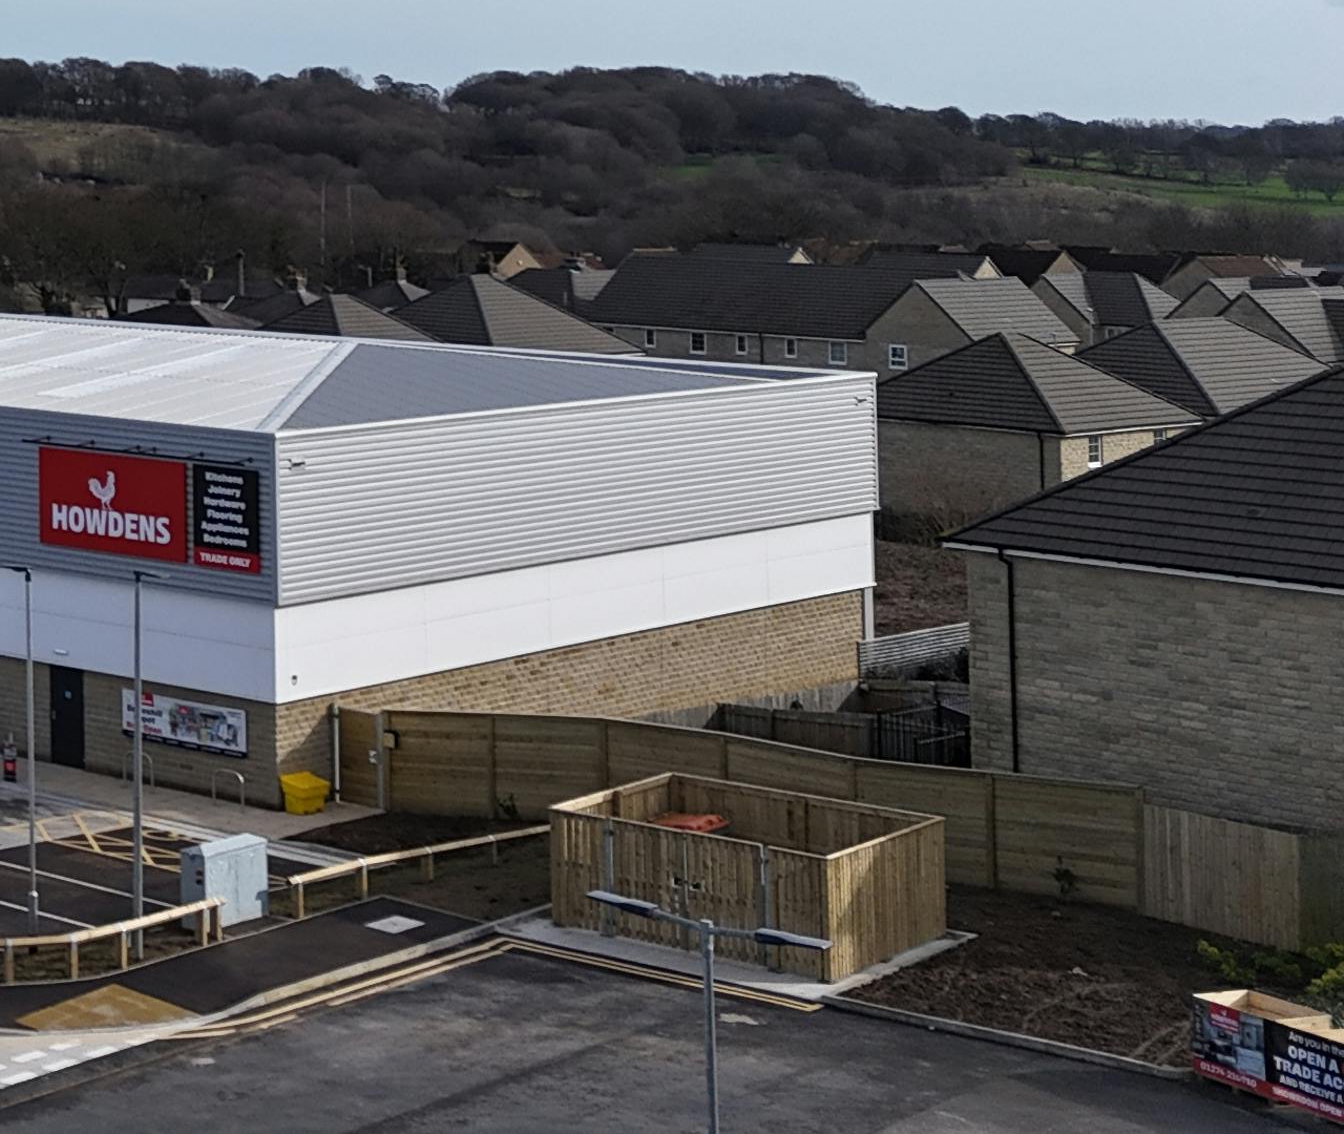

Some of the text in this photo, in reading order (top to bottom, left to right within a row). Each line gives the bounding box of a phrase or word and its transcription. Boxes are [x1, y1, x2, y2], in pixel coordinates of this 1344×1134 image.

[204, 471, 244, 485] Kitchens
[207, 484, 242, 498] Joinery
[203, 496, 246, 511] Hardware
[51, 503, 171, 545] HOWDENS
[206, 508, 243, 524] Flooring
[200, 520, 250, 536] Appliances
[203, 533, 247, 548] Bedrooms
[200, 552, 251, 568] TRADE ONLY
[1288, 1031, 1304, 1044] Are
[1304, 1038, 1321, 1050] you
[1321, 1041, 1330, 1053] in
[1287, 1044, 1340, 1074] OPEN A
[1199, 1061, 1225, 1076] 01274
[1272, 1054, 1344, 1091] TRADE AC
[1279, 1074, 1344, 1104] AND RECEIVE A
[1319, 1102, 1342, 1117] OPEN
